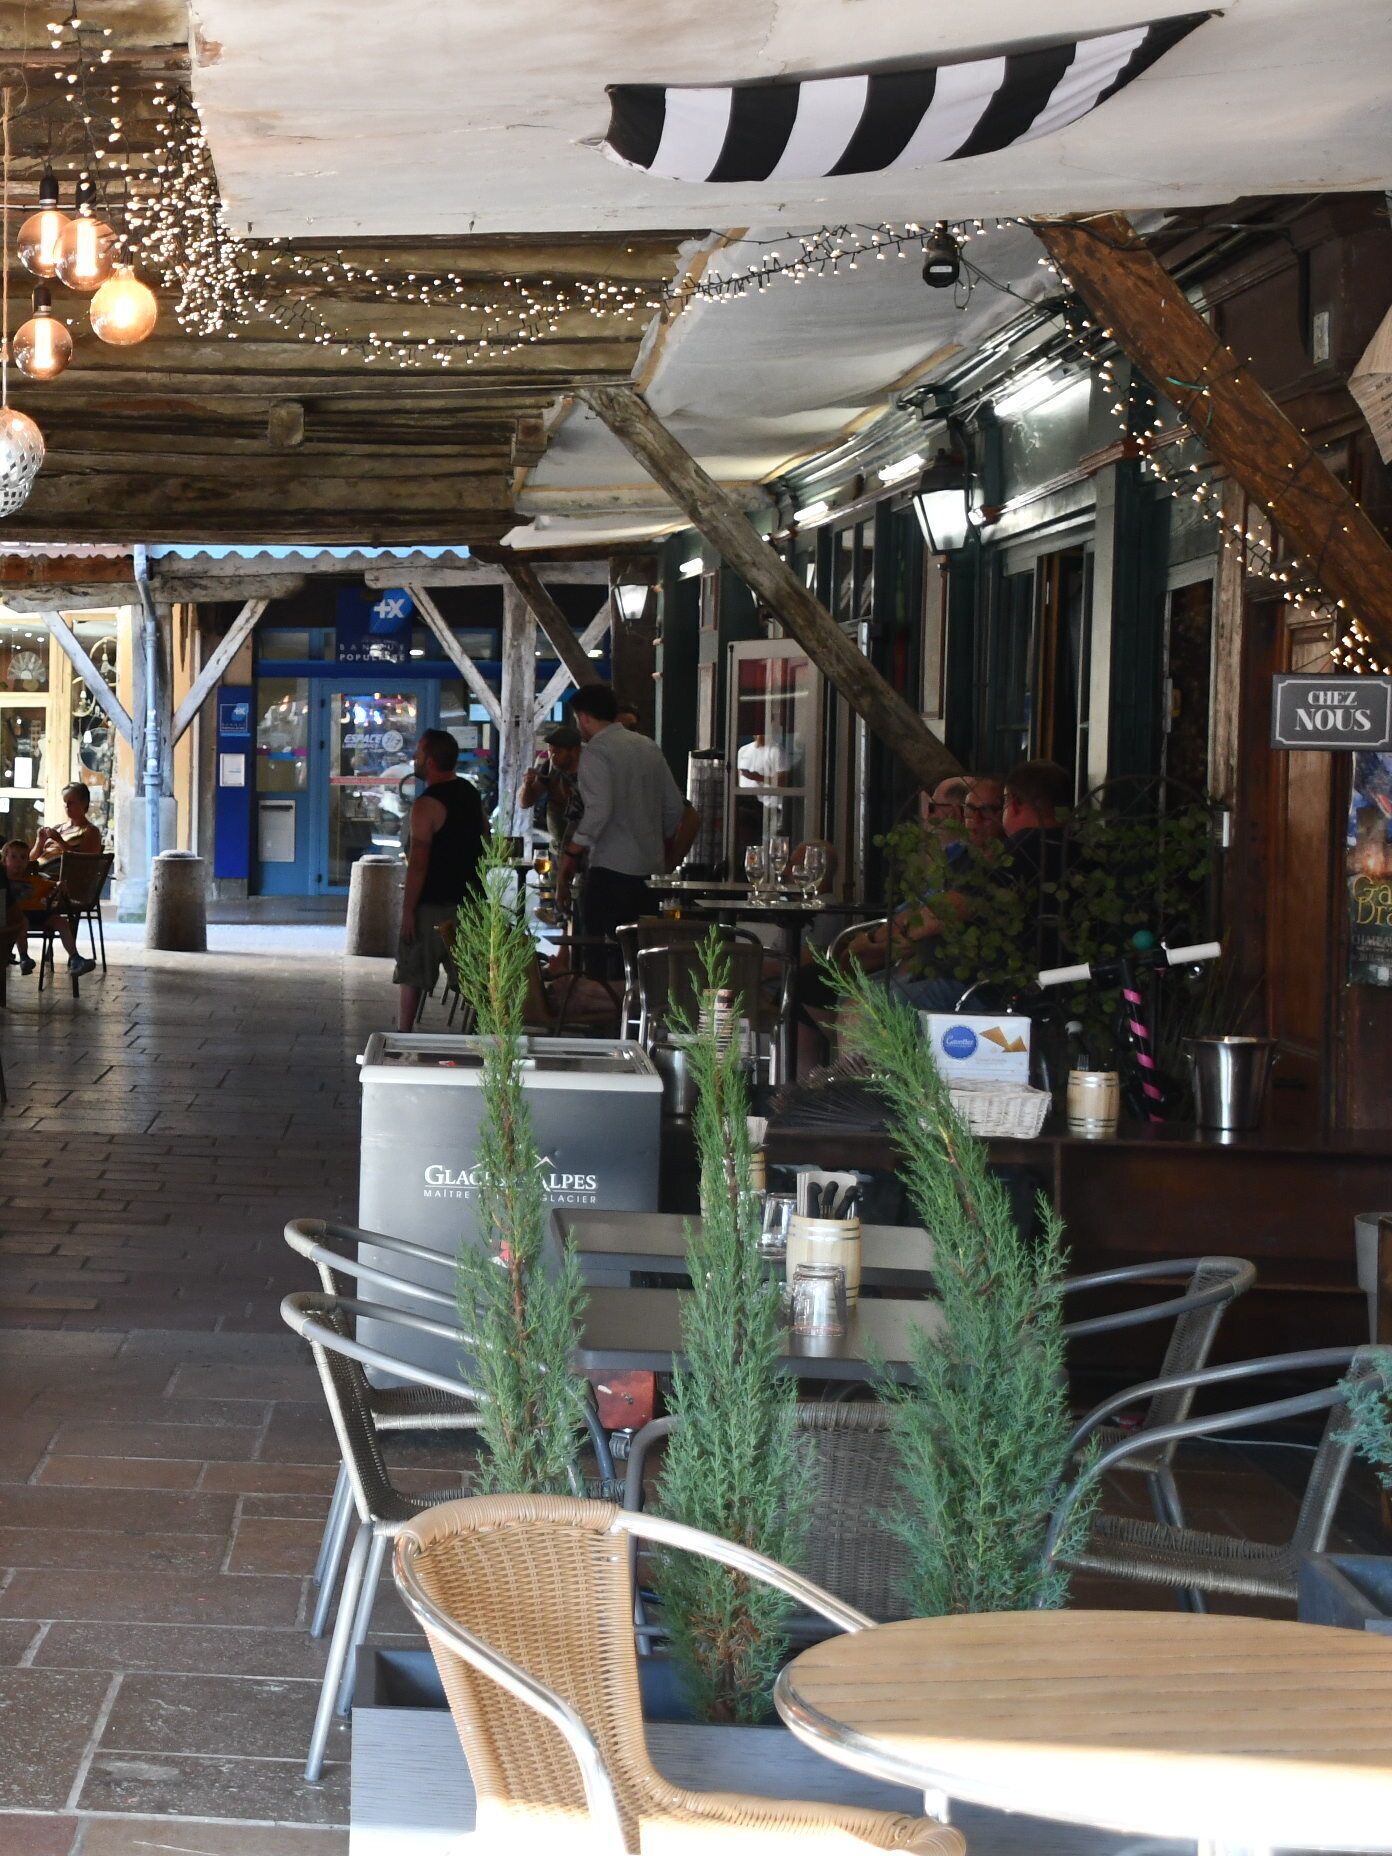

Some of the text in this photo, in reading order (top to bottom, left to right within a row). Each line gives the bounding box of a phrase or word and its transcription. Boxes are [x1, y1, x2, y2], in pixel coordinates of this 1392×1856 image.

[339, 653, 405, 662] POPULARE
[1307, 690, 1358, 706] CHEZ
[1295, 708, 1372, 732] NOUS
[424, 1164, 505, 1186] GLAC
[423, 1188, 470, 1199] MAÎTRE
